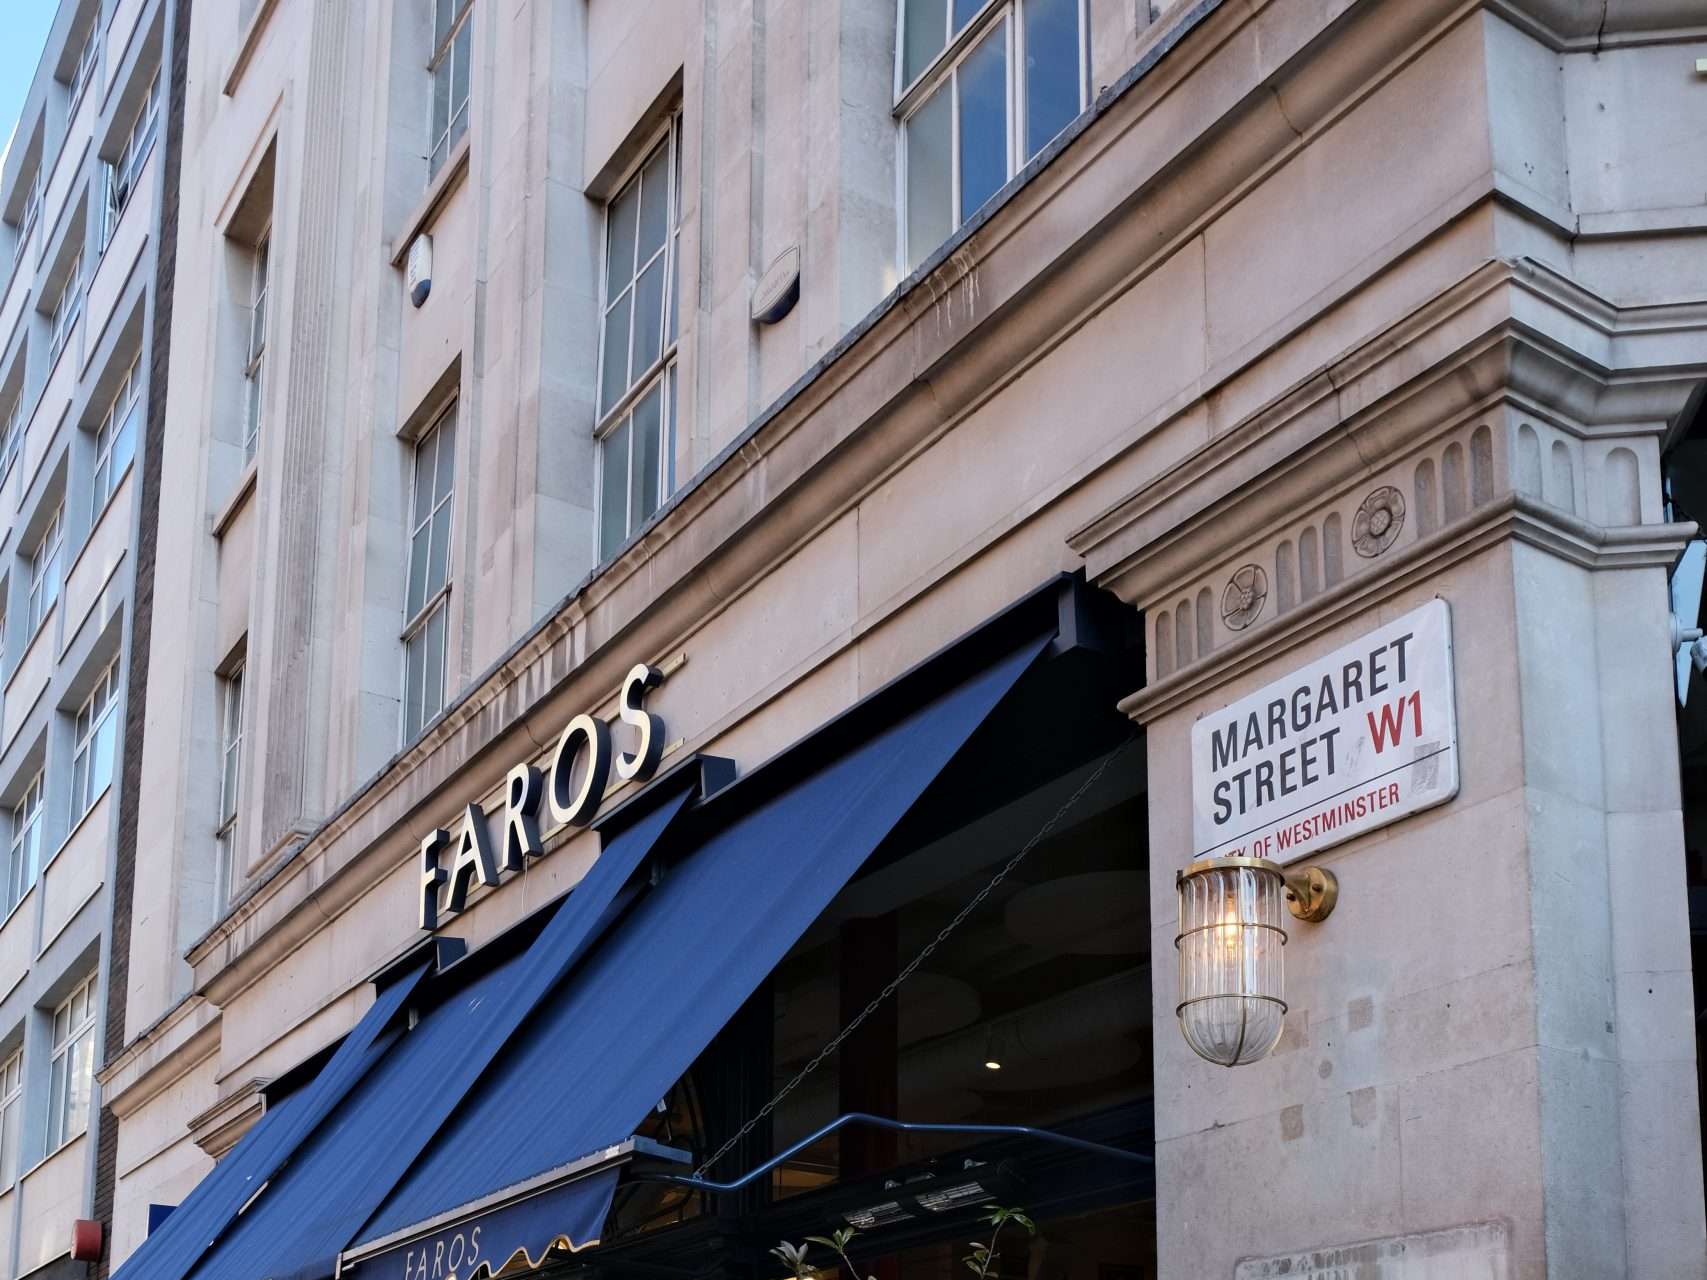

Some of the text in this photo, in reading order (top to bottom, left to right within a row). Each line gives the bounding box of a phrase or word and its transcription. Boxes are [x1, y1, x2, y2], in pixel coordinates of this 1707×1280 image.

[1211, 632, 1414, 773] MARGARET
[1213, 690, 1423, 826] STREET W1
[419, 663, 666, 932] FAROS
[1253, 782, 1400, 858] OF WESTMINSTER
